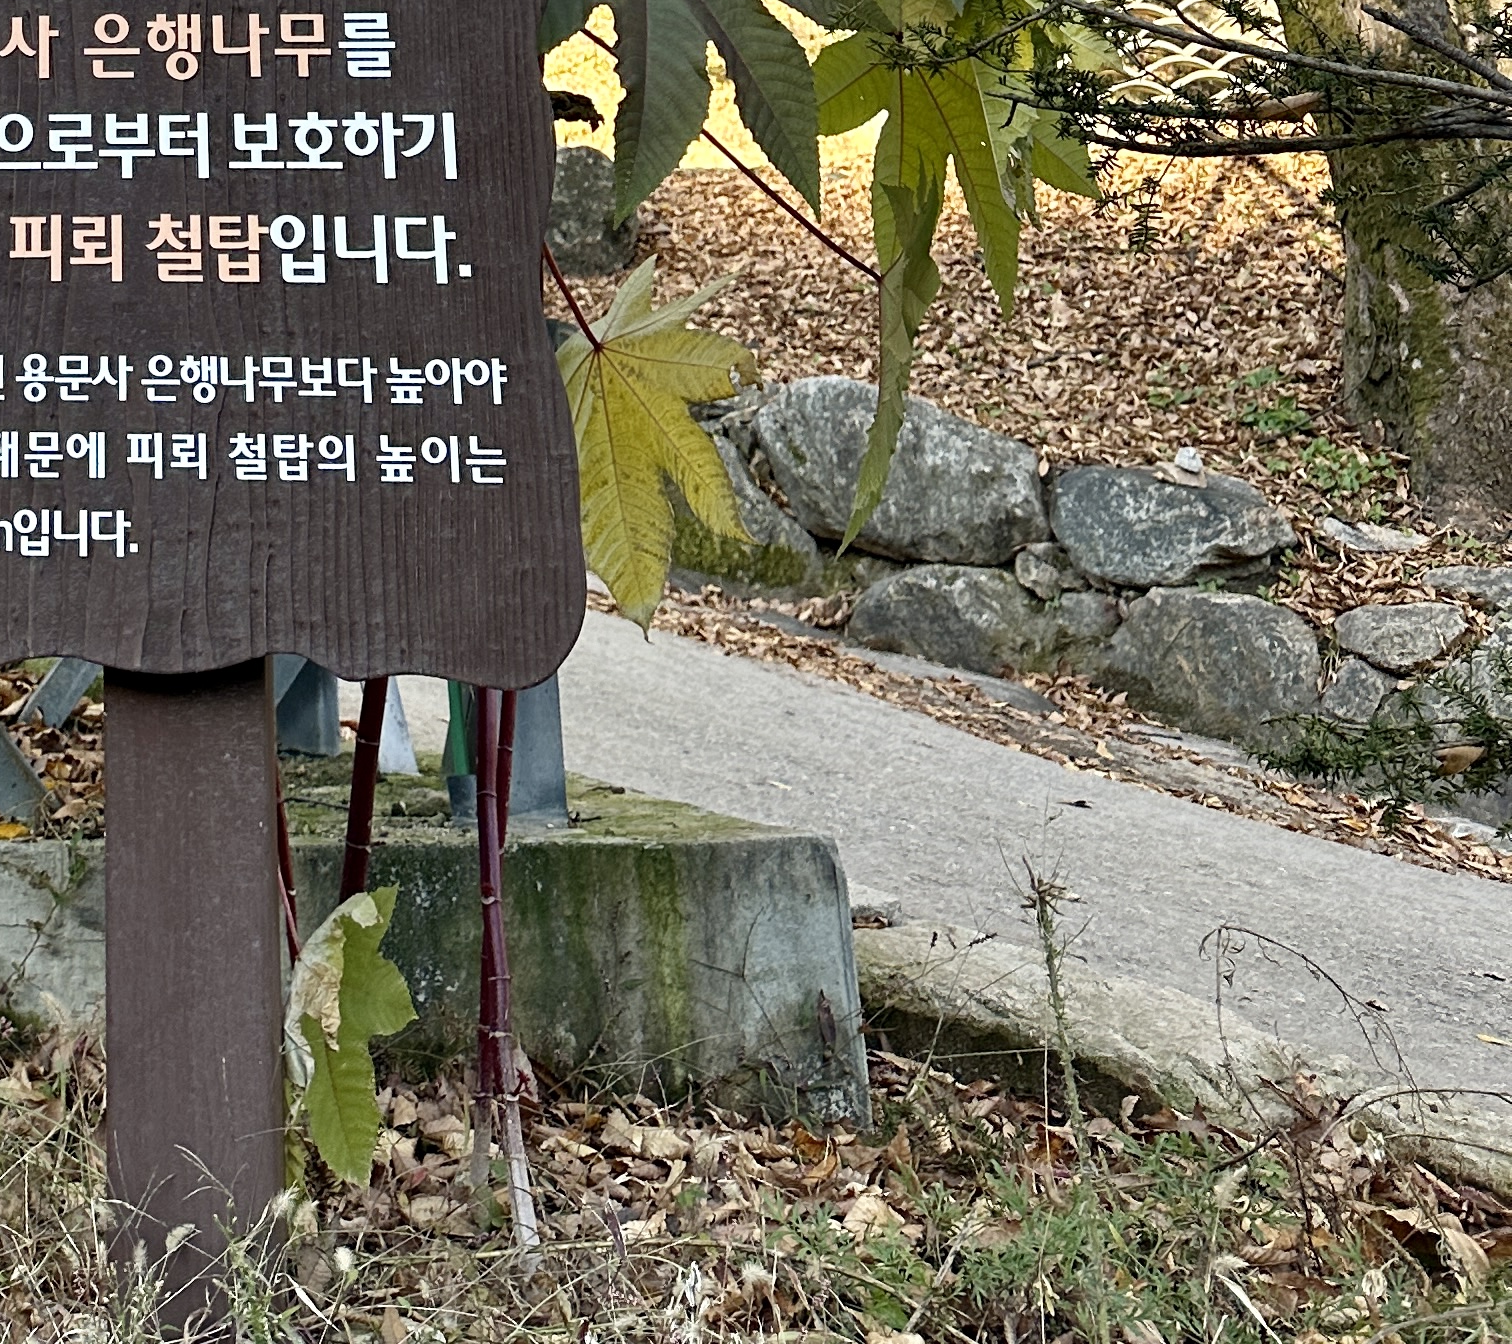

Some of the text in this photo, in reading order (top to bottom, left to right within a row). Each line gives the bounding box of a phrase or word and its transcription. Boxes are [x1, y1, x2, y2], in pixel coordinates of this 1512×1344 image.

[83, 12, 396, 81] 은행나무를
[228, 111, 458, 180] 보호하기
[9, 214, 123, 282] 피뢰
[144, 213, 472, 285] 철탑입니다.
[15, 353, 134, 403] 용문사
[140, 354, 378, 404] 은행나무보다
[385, 357, 508, 405] 높아야
[126, 432, 207, 480] 피뢰
[228, 432, 356, 482] 철탑의
[375, 434, 507, 484] 높이는
